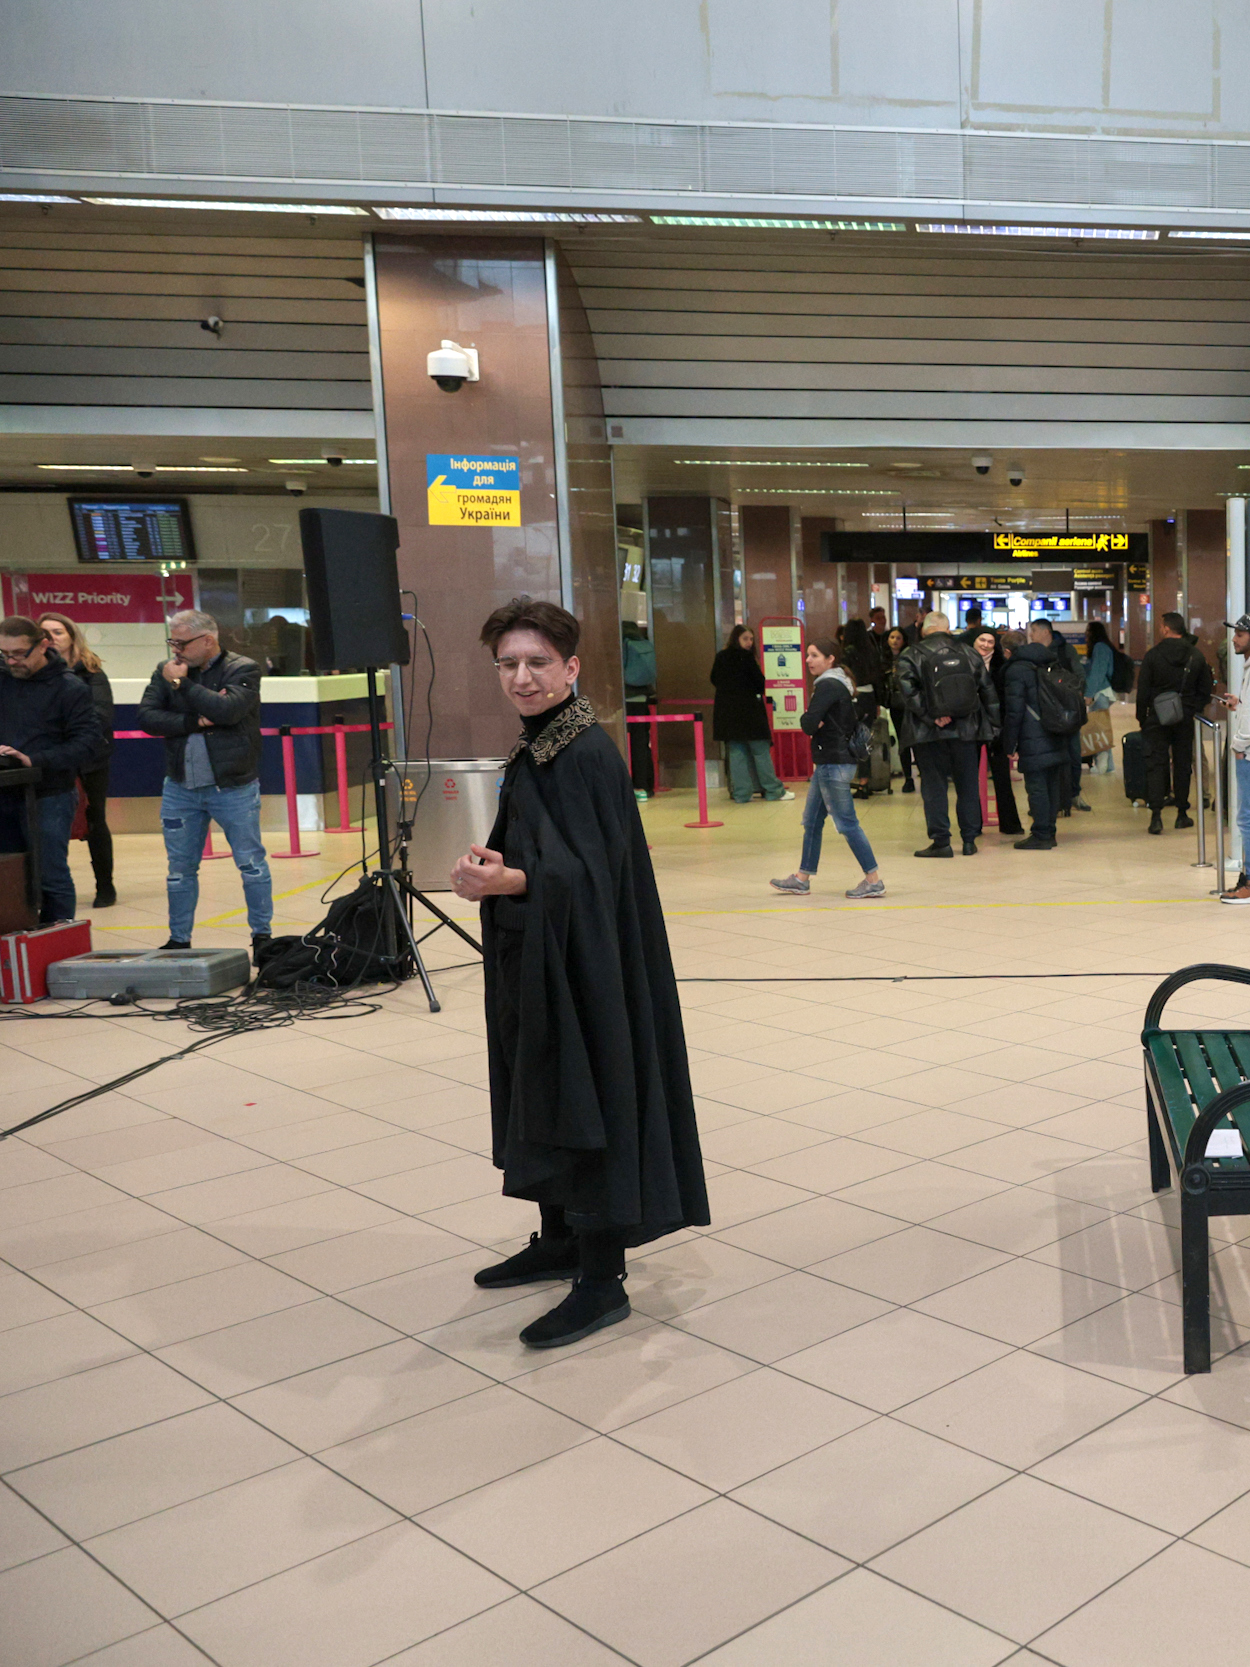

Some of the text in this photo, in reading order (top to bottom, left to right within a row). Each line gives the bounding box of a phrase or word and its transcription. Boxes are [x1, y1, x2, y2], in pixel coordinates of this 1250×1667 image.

[450, 458, 516, 473] Інформація
[473, 475, 495, 487] для
[457, 495, 512, 505] громадян
[459, 507, 510, 523] України
[251, 523, 293, 551] 27
[32, 592, 131, 606] WIZZ Priority
